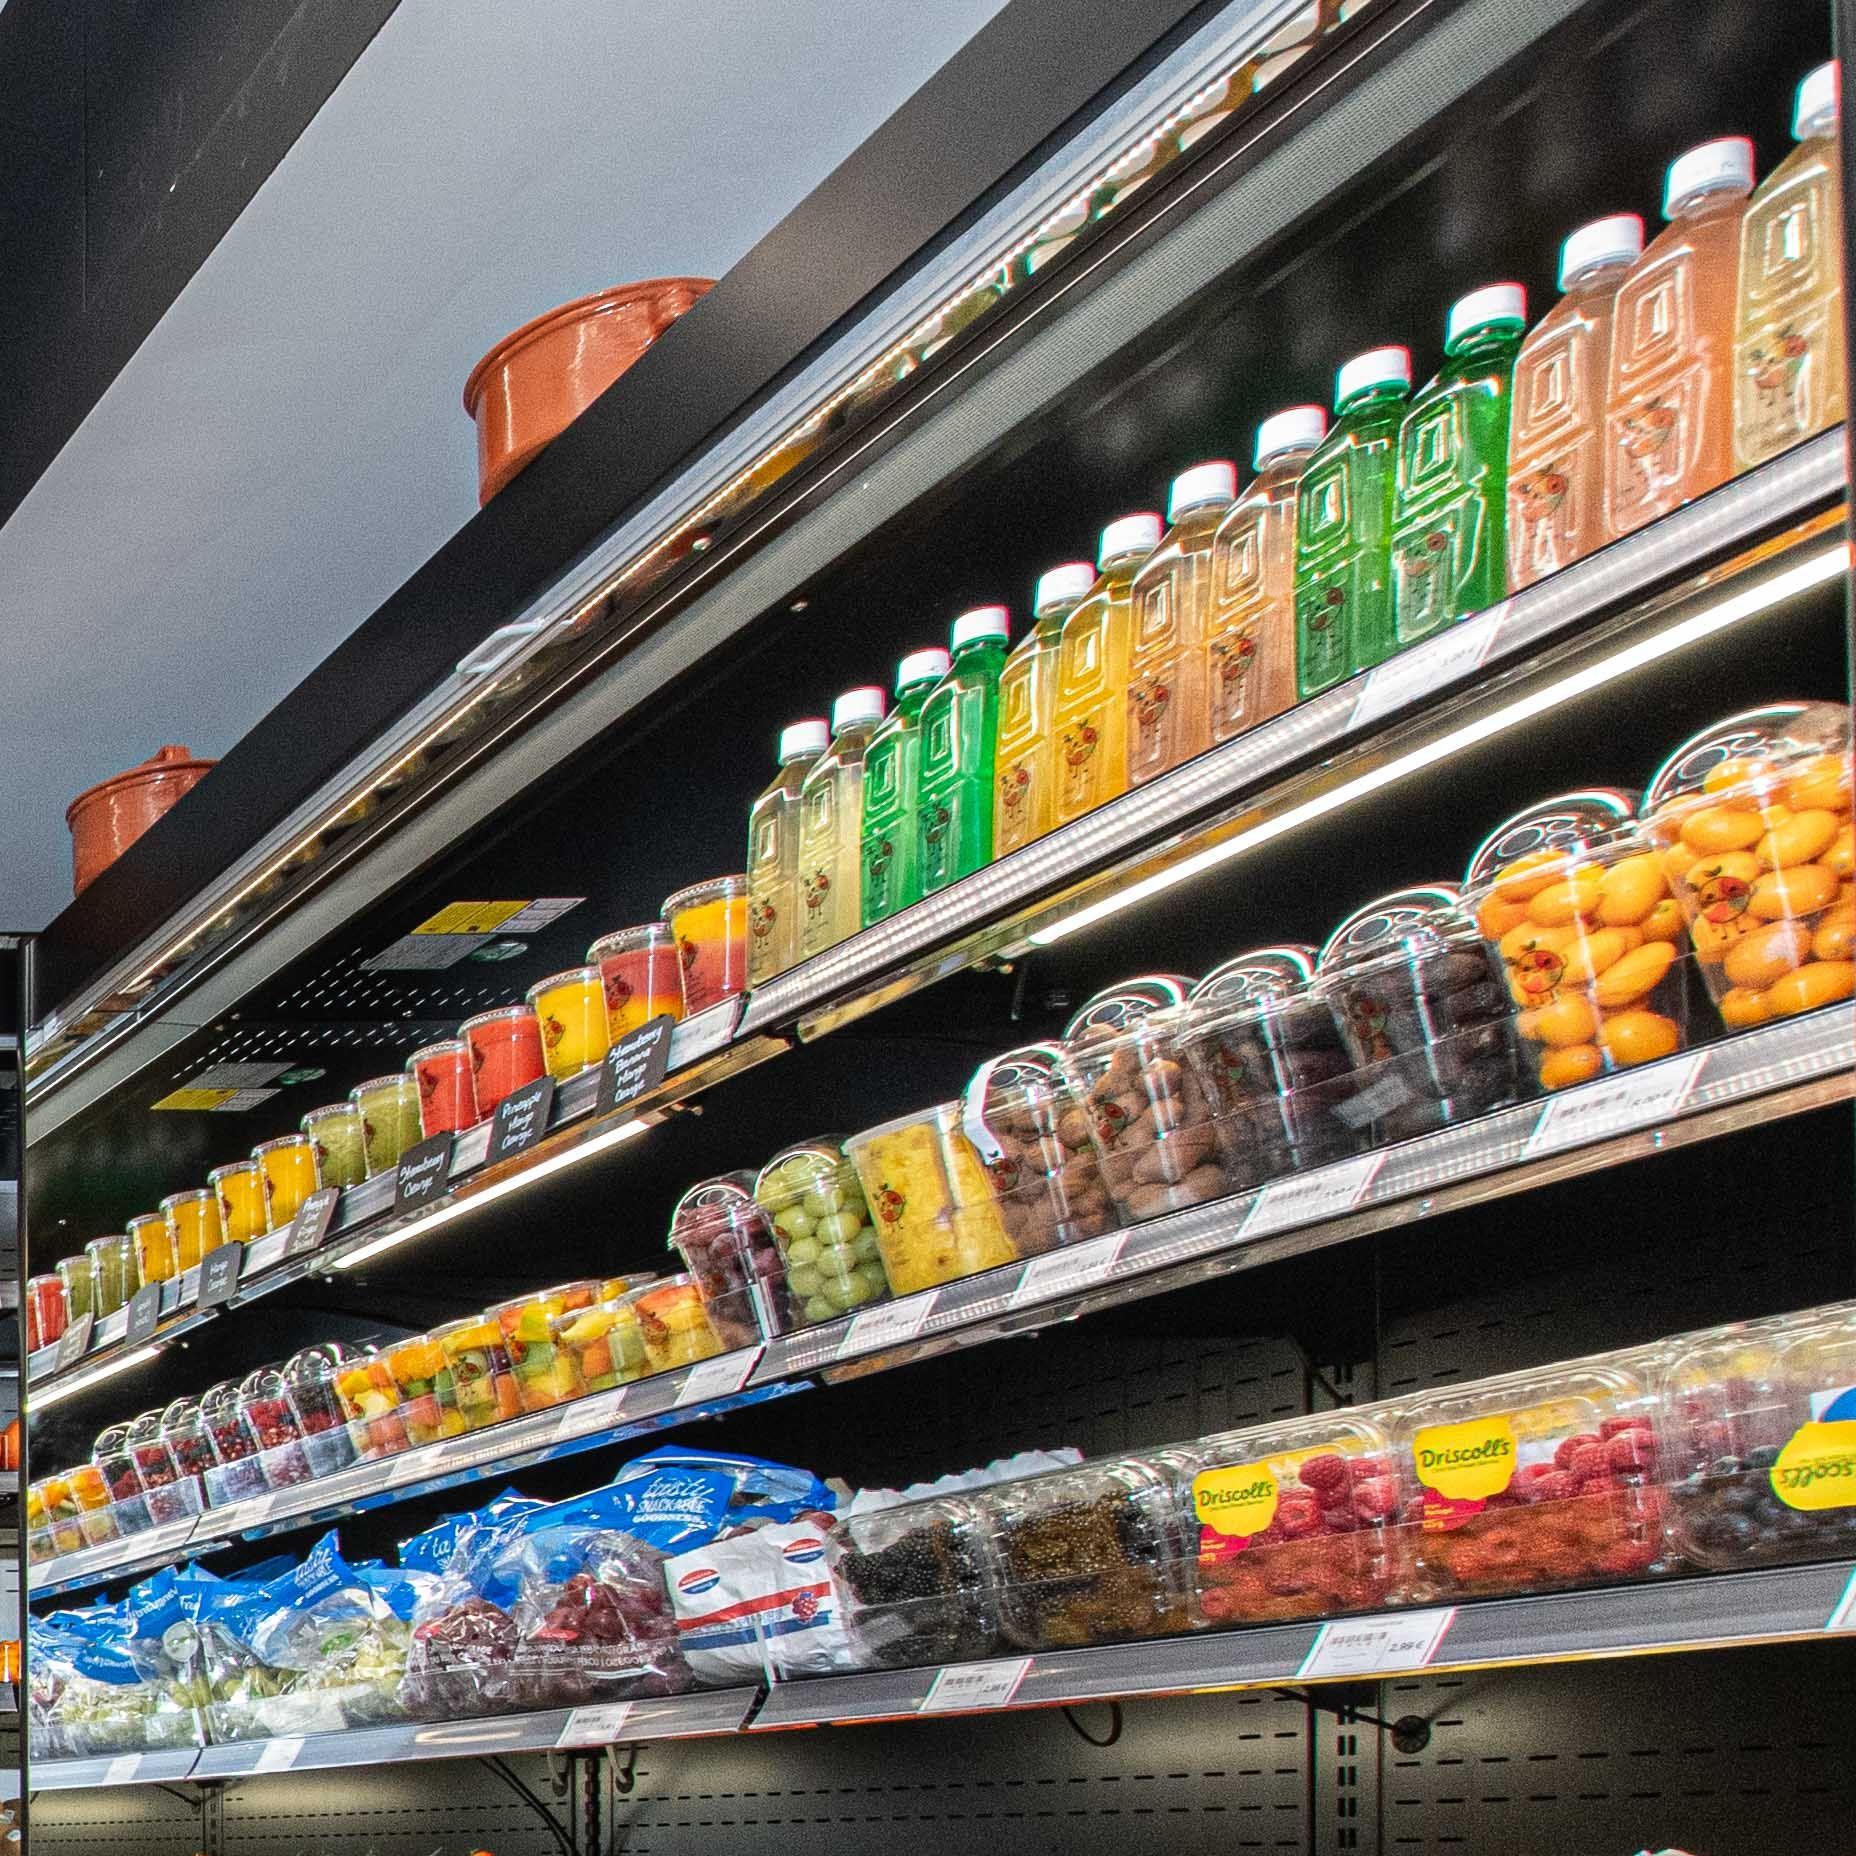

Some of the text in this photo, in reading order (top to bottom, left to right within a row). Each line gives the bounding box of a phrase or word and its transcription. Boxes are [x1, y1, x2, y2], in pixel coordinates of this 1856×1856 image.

[1419, 1438, 1511, 1468] Driscoll's
[1780, 1462, 1855, 1488] scoll's
[1198, 1480, 1274, 1507] Driscoll's
